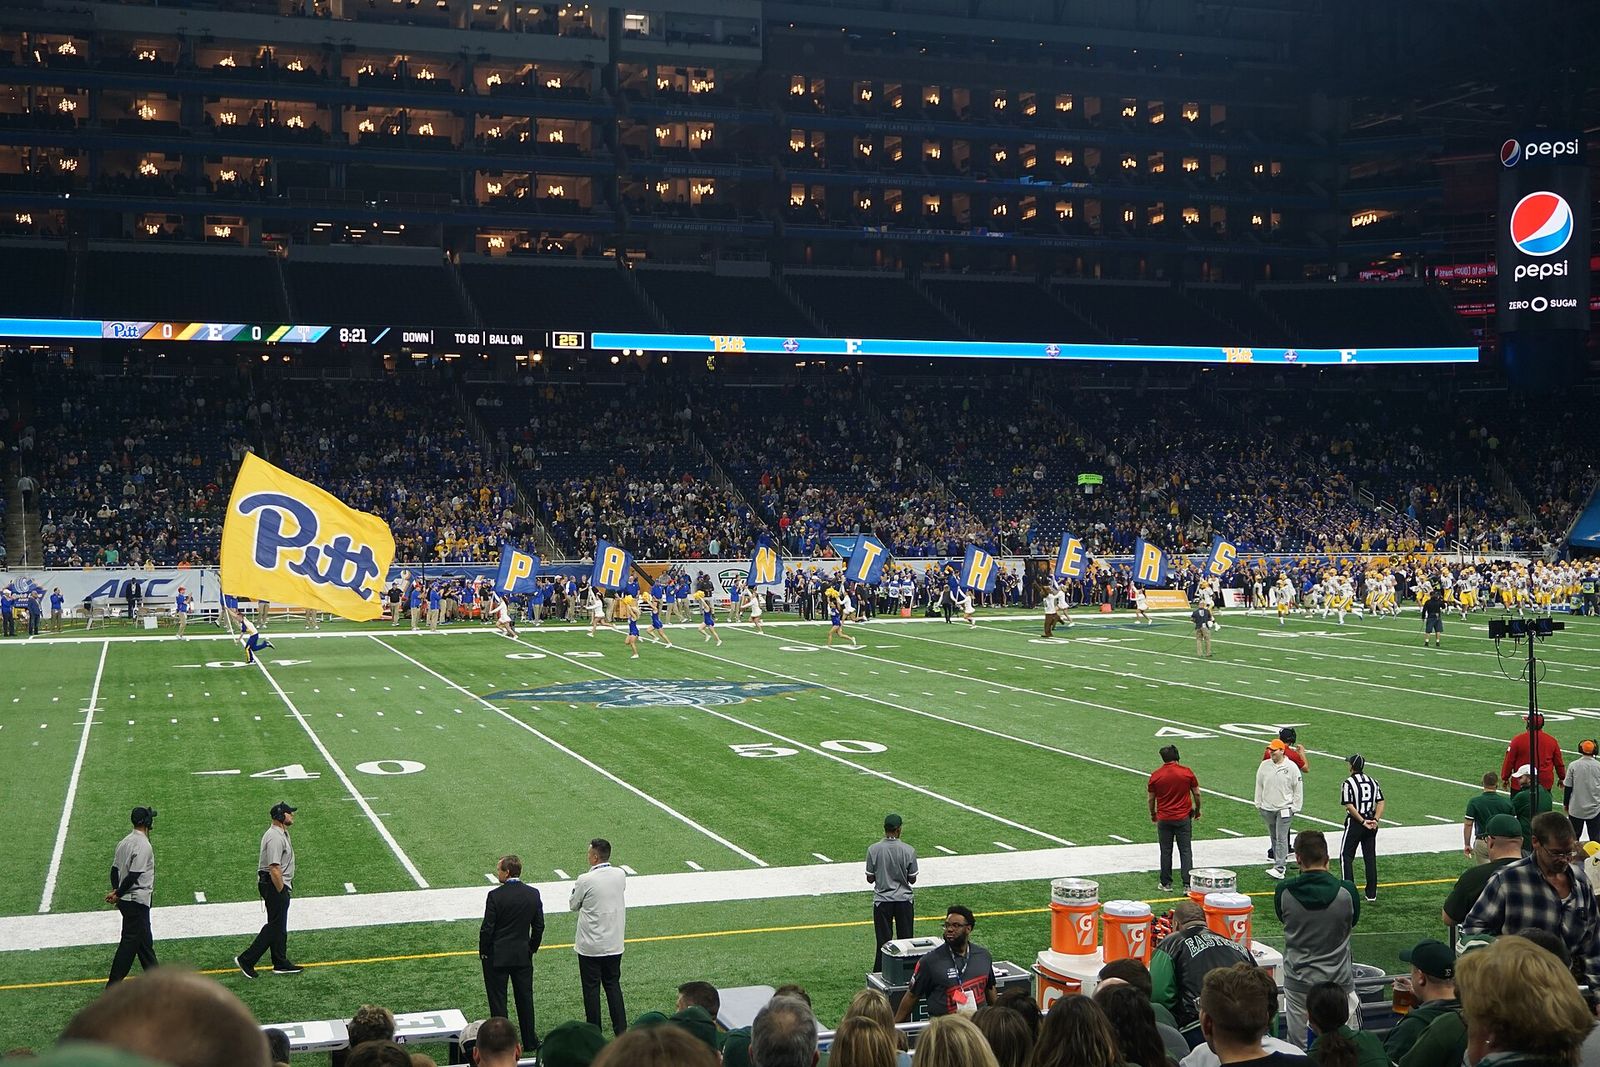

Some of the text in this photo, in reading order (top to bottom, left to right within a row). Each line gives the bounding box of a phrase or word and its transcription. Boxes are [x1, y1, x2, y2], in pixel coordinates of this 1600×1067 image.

[1525, 139, 1578, 160] pepsi
[1514, 260, 1568, 282] pepsi
[1508, 298, 1577, 310] ZERO SUGAR
[111, 322, 139, 339] Pitt
[162, 324, 173, 339] 0
[207, 323, 223, 340] E
[251, 326, 262, 341] 0
[340, 329, 367, 343] 8:21
[402, 332, 429, 343] DOWN
[454, 333, 480, 344] TO GO
[489, 334, 523, 345] BALL ON
[559, 334, 578, 347] 25
[709, 336, 746, 353] Pitt
[845, 339, 863, 353] E
[1222, 347, 1254, 364] Pitt
[1339, 349, 1357, 363] E
[238, 491, 380, 602] Pitt
[755, 546, 777, 583] N
[858, 540, 882, 581] T
[1061, 537, 1083, 576] E
[1209, 541, 1236, 576] S
[503, 550, 533, 592] P
[599, 546, 625, 587] A
[966, 549, 993, 591] H
[1360, 783, 1372, 801] B
[1079, 914, 1092, 931] G
[1233, 919, 1246, 933] G
[1131, 927, 1144, 942] G
